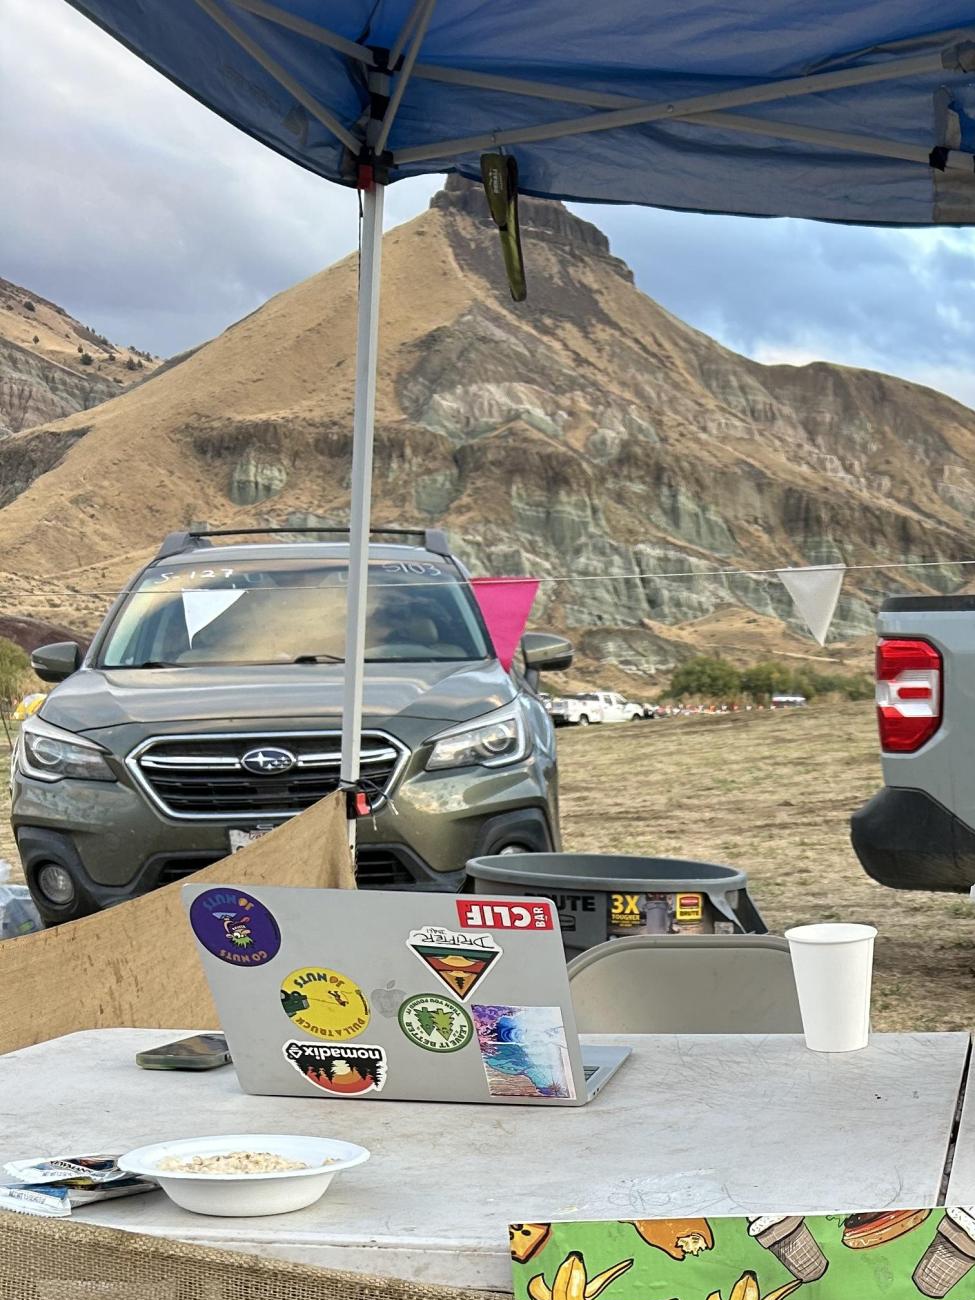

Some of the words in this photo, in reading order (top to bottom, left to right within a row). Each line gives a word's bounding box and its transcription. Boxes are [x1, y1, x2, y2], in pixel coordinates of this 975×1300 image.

[203, 894, 237, 912] NUTS
[611, 894, 640, 914] 3X
[466, 905, 532, 927] CLIF
[532, 907, 547, 928] BAR
[413, 932, 495, 949] DRIFTER
[219, 948, 249, 962] NUTS
[252, 949, 267, 962] GO
[294, 972, 328, 988] NUTS
[429, 998, 444, 1006] YOU
[444, 1001, 462, 1017] THAN
[294, 1016, 334, 1037] TRUCK
[334, 1028, 344, 1037] A
[405, 1021, 437, 1049] BETTER
[449, 1024, 467, 1046] LEAVE
[302, 1045, 380, 1062] nomadix
[438, 1041, 450, 1049] IT
